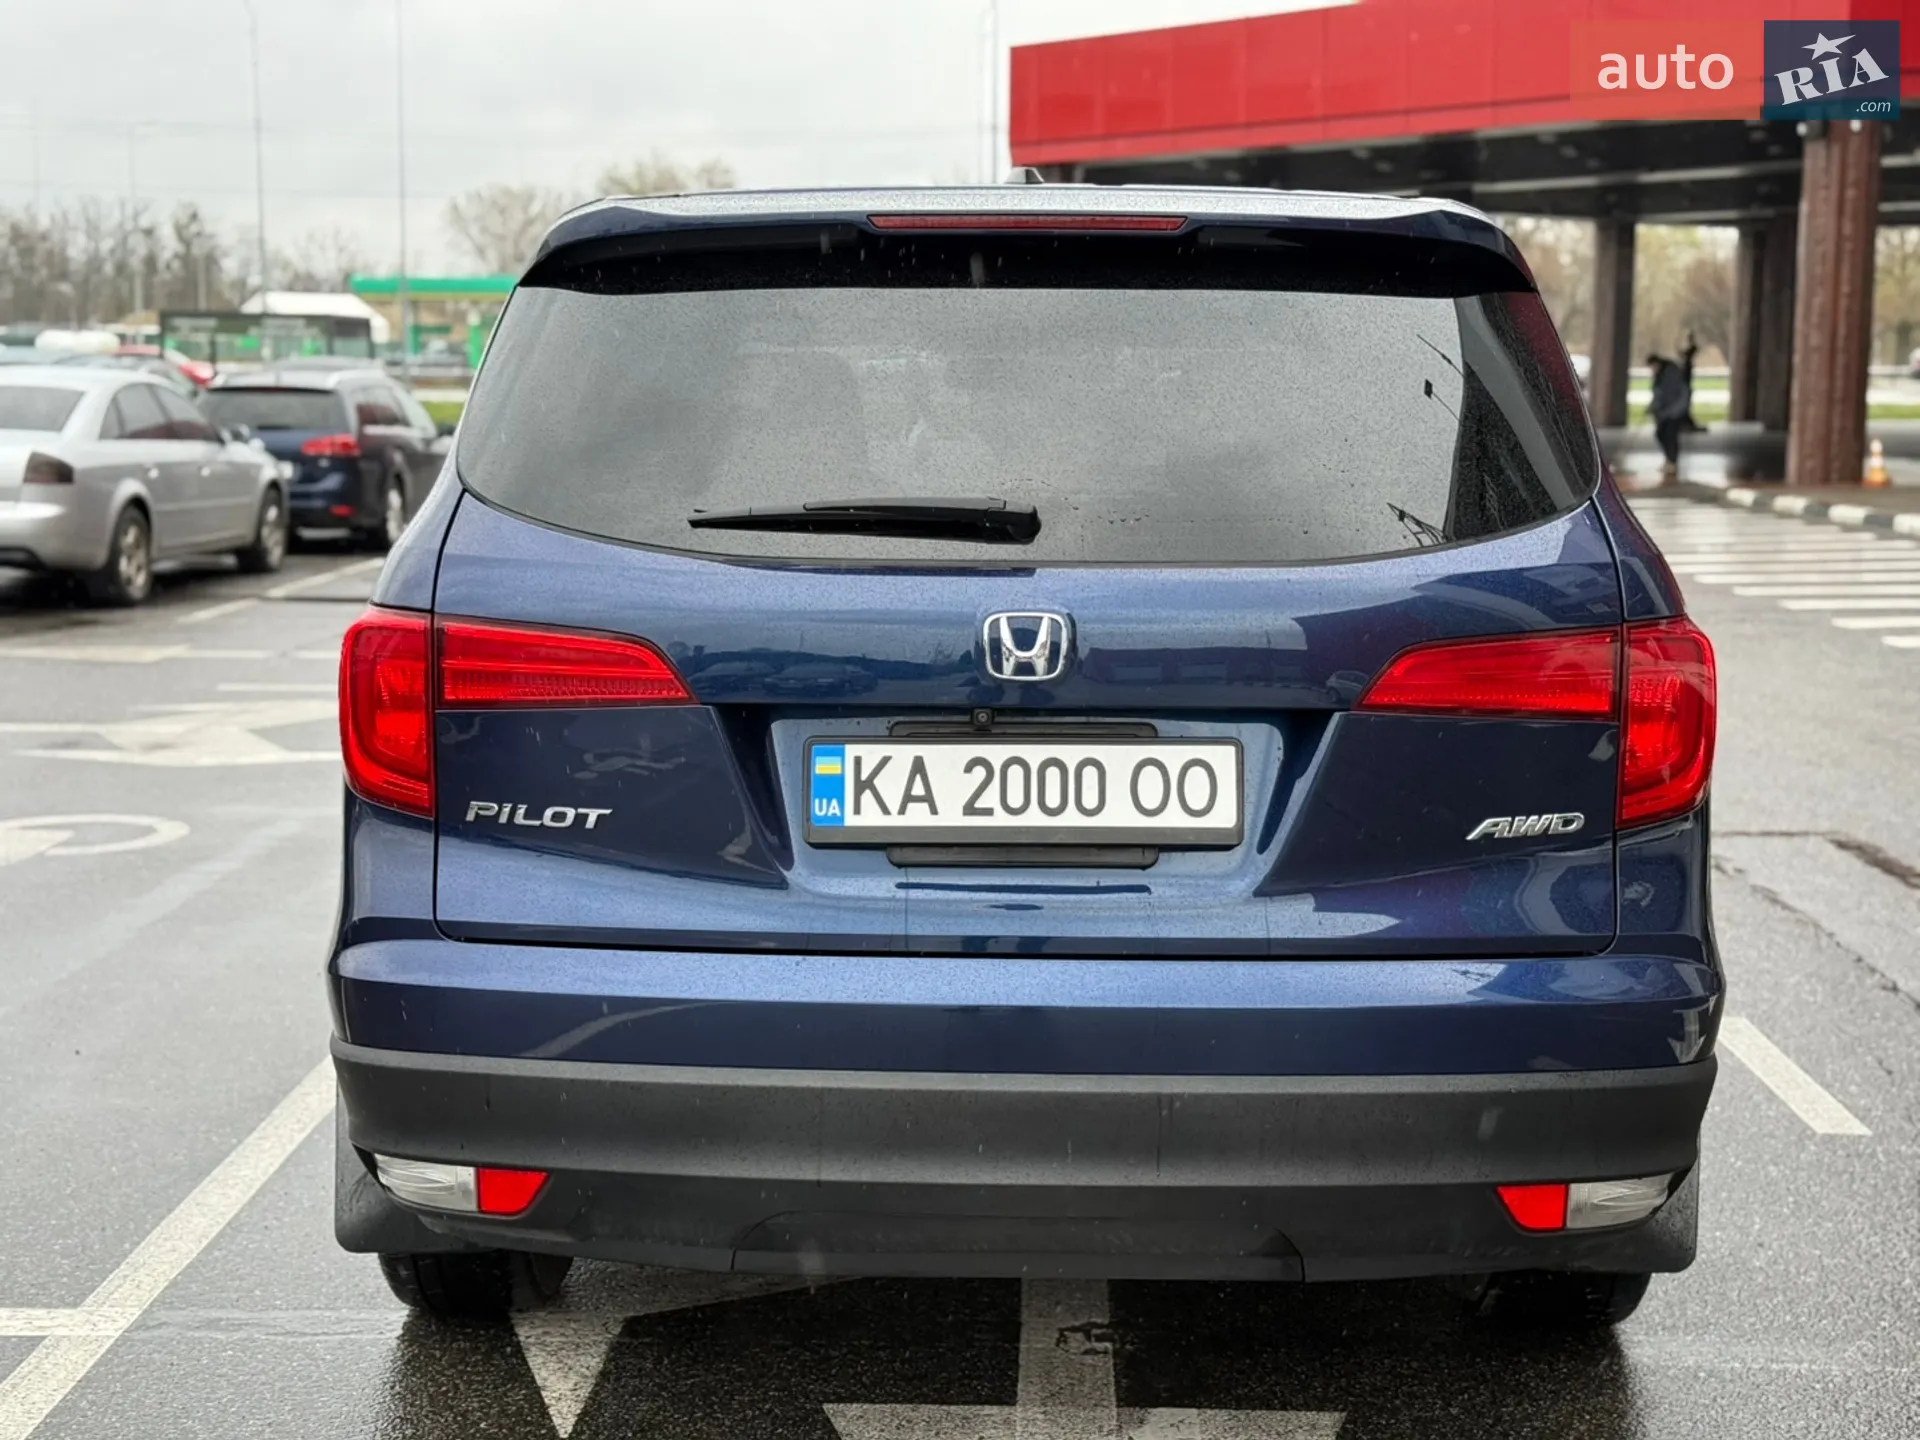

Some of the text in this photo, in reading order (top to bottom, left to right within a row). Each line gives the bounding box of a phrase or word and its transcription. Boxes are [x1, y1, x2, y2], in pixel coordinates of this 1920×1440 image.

[852, 755, 1218, 817] KA 2000 OO
[465, 800, 613, 829] PILOT
[814, 798, 841, 817] UA
[1465, 812, 1585, 840] AWD
